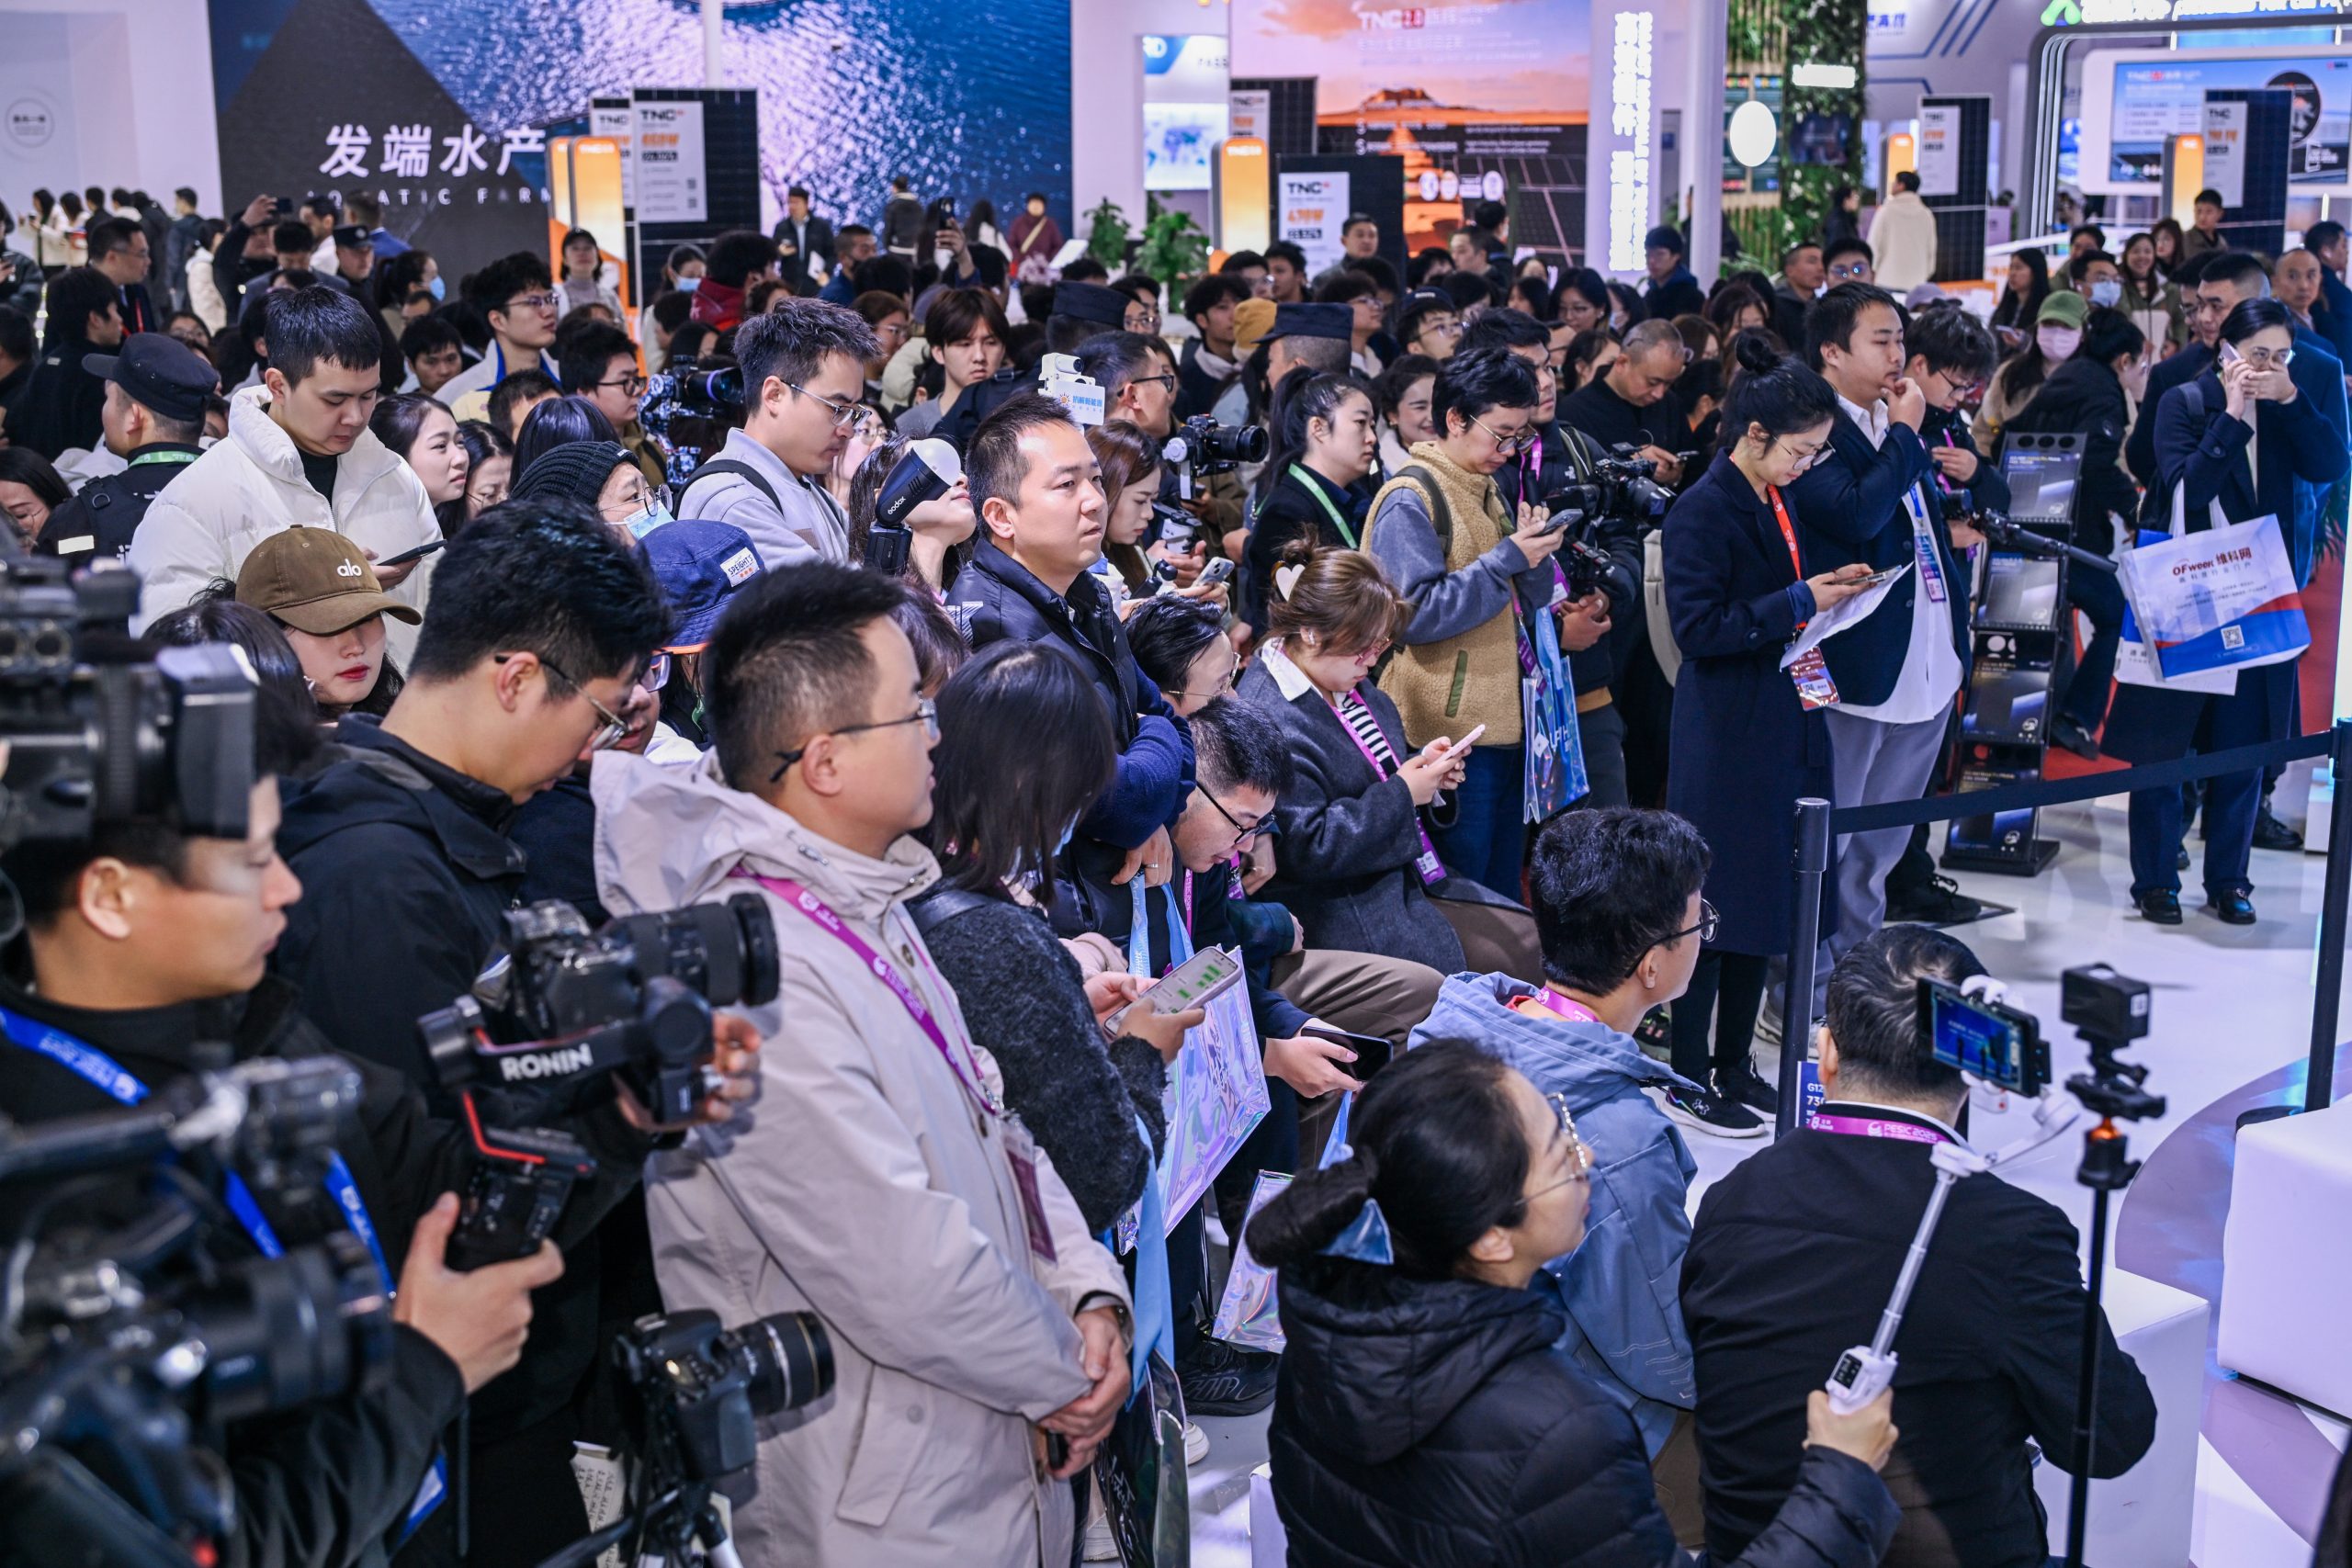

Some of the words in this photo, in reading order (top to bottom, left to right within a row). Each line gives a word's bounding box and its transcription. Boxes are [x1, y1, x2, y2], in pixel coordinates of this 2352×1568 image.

[319, 123, 546, 178] 发端水产
[307, 187, 451, 209] QATIC
[336, 558, 363, 577] alo
[499, 1042, 594, 1082] RONIN
[1883, 1123, 1912, 1135] PESIC
